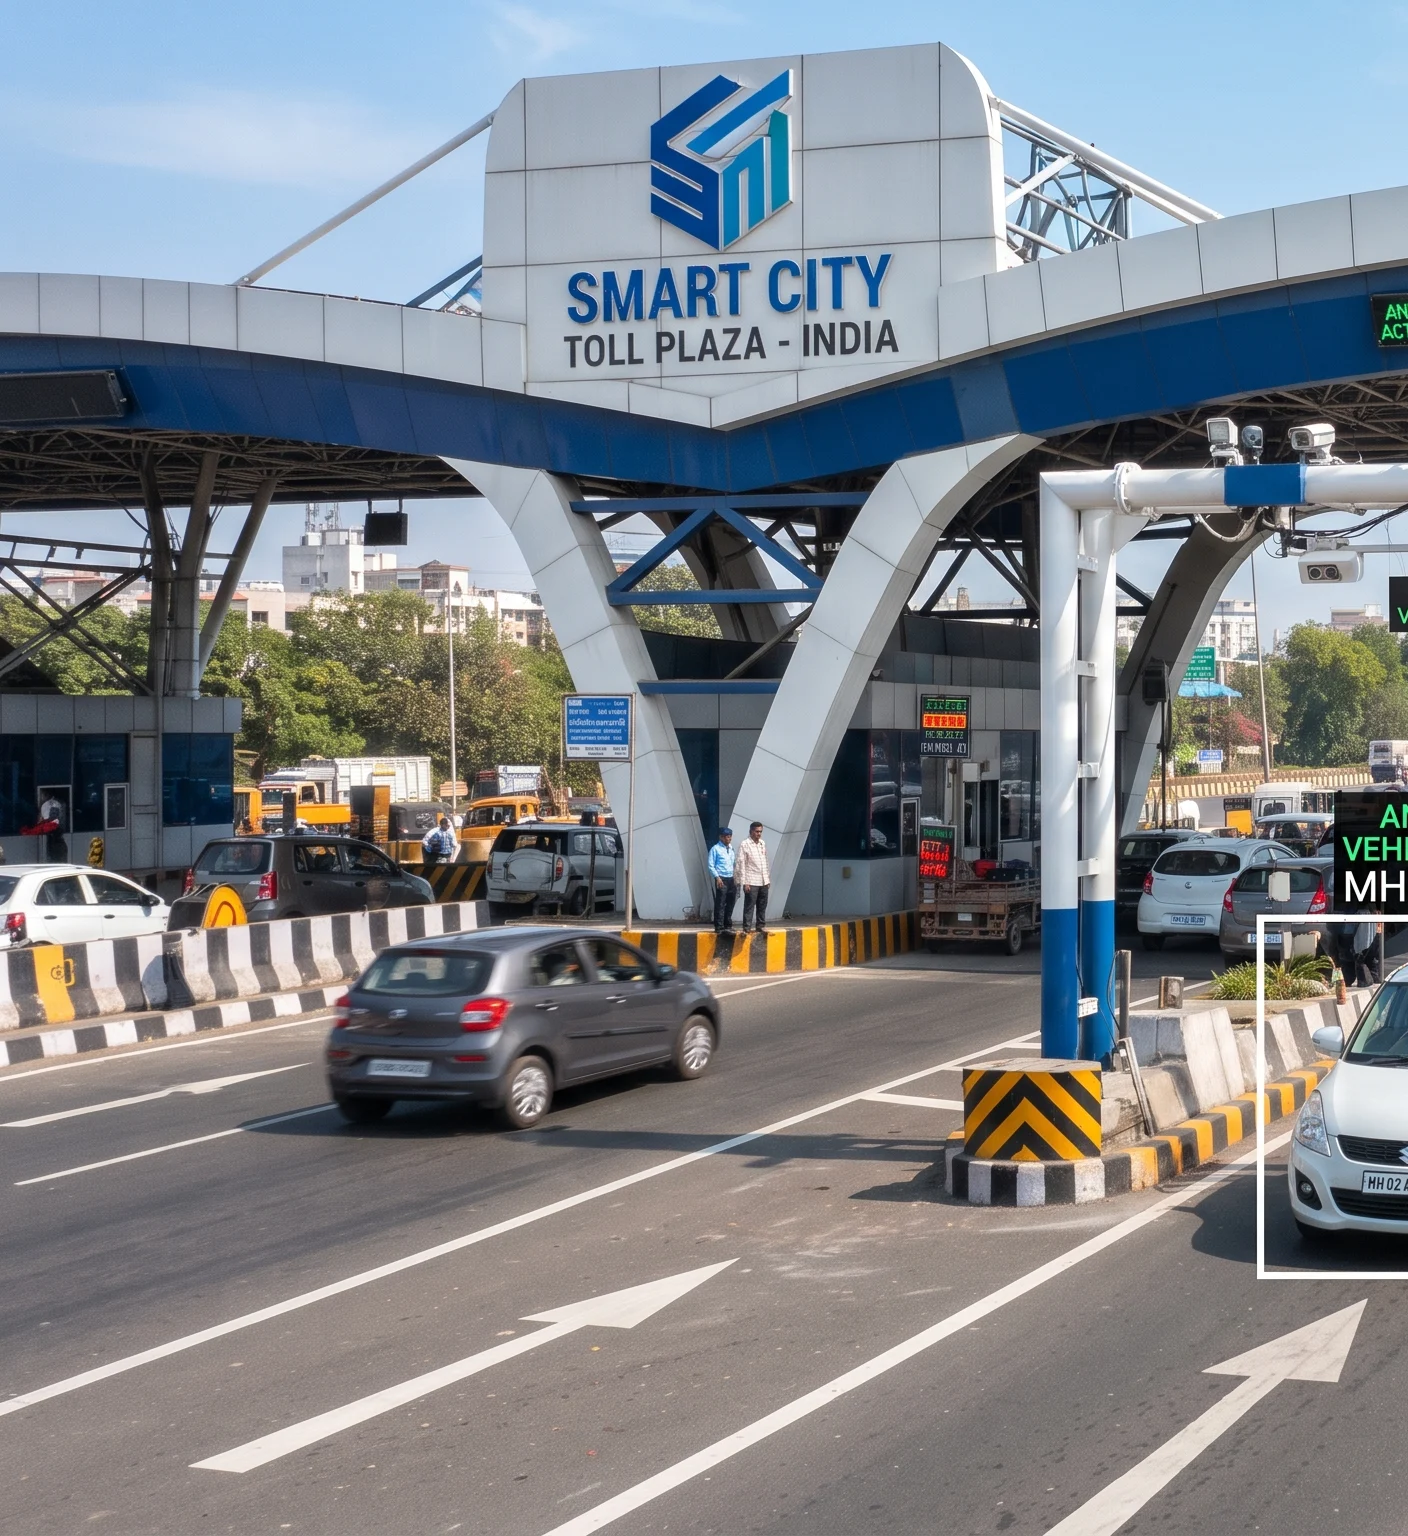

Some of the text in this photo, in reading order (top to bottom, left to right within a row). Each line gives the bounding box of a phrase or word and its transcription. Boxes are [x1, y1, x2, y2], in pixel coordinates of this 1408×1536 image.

[567, 253, 893, 325] SMART CITY
[564, 331, 645, 368] TOLL
[655, 326, 766, 364] PLAZA
[802, 319, 899, 357] INDIA
[1367, 1176, 1385, 1190] MH
[1386, 1177, 1402, 1191] 02
